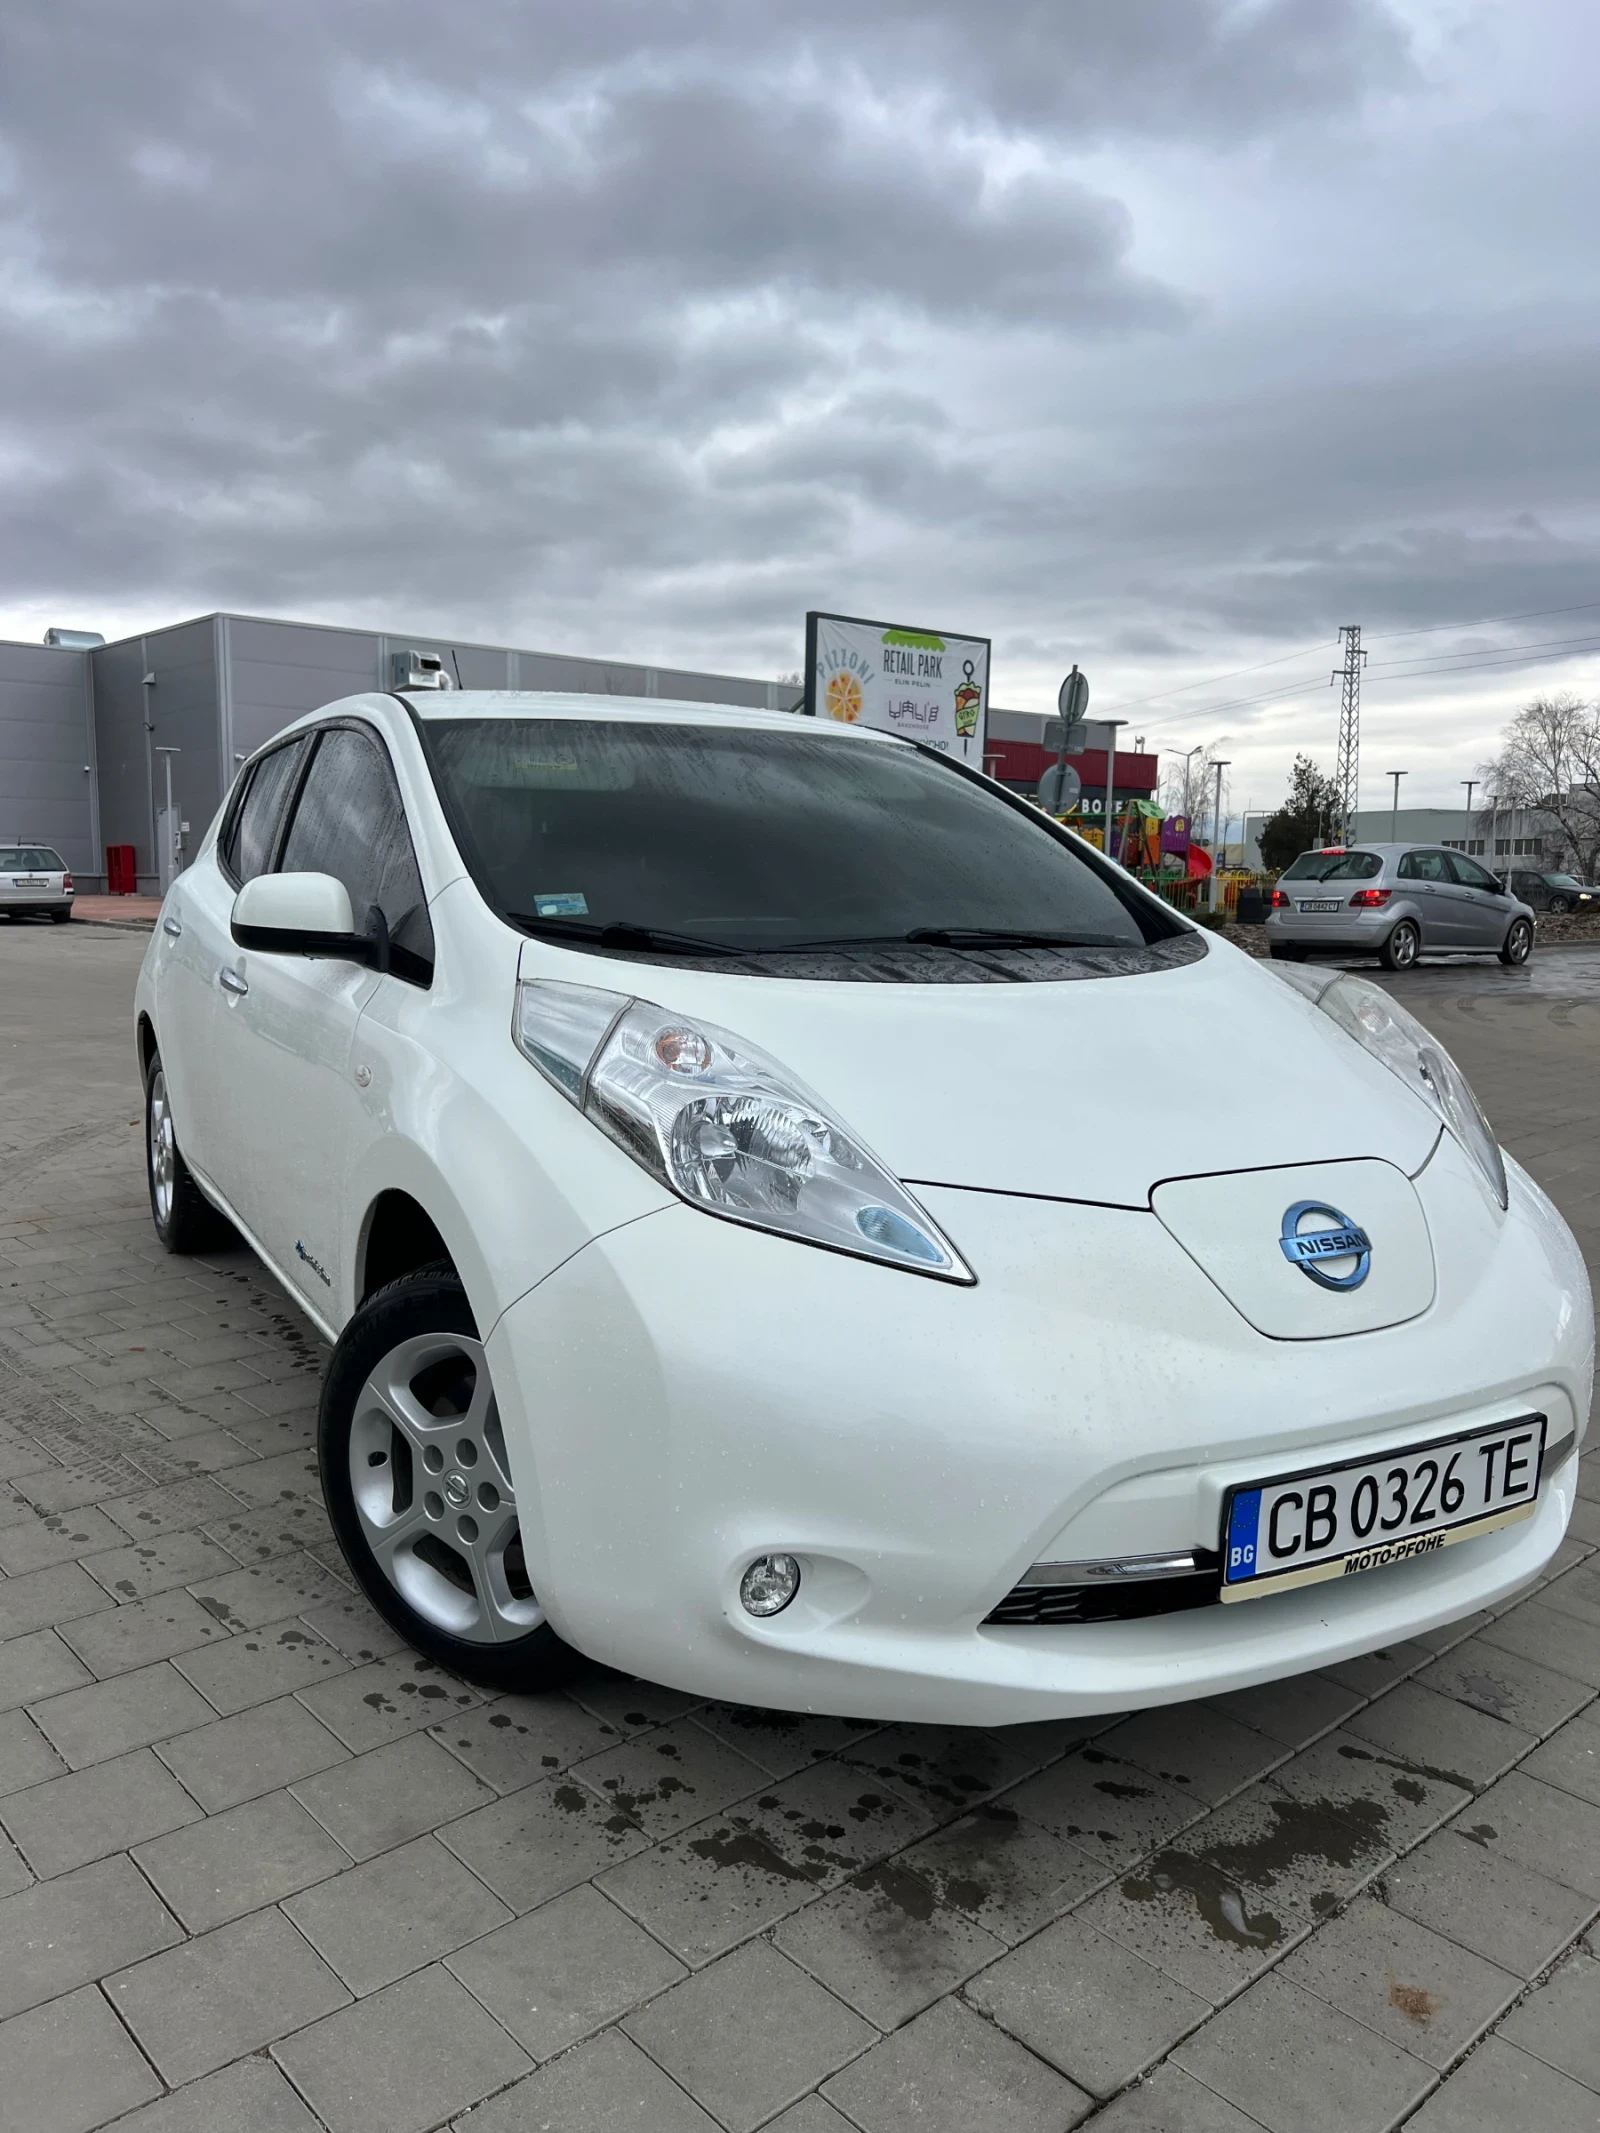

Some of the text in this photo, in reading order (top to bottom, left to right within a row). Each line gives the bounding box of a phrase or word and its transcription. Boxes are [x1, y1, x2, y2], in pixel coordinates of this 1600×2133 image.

[817, 648, 875, 685] PIZZONI
[883, 649, 943, 679] RETAIL PARK
[894, 678, 931, 688] ELIN PELIN
[1296, 1233, 1368, 1255] NISSAN
[1268, 1433, 1533, 1559] CB 0326 TE
[1231, 1545, 1255, 1567] BG
[1344, 1531, 1447, 1575] MOTO-PFOHE
